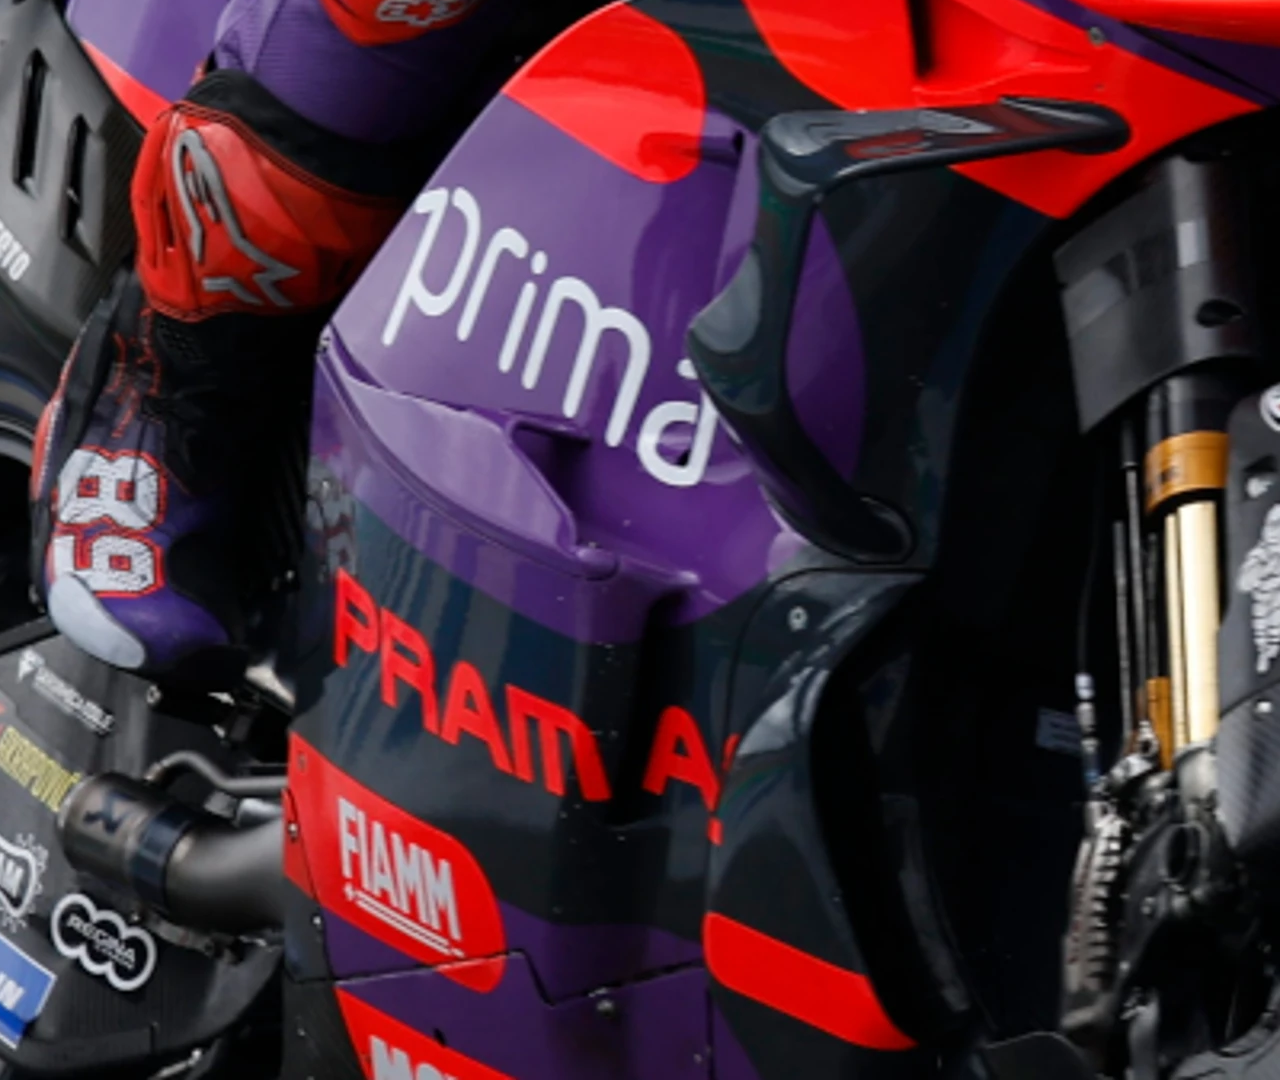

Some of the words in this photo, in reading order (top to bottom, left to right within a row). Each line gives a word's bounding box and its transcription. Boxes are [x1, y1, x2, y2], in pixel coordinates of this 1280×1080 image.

[380, 187, 720, 488] prima
[53, 444, 168, 600] 89
[334, 565, 741, 846] PRAMA
[338, 795, 463, 942] FIAMM
